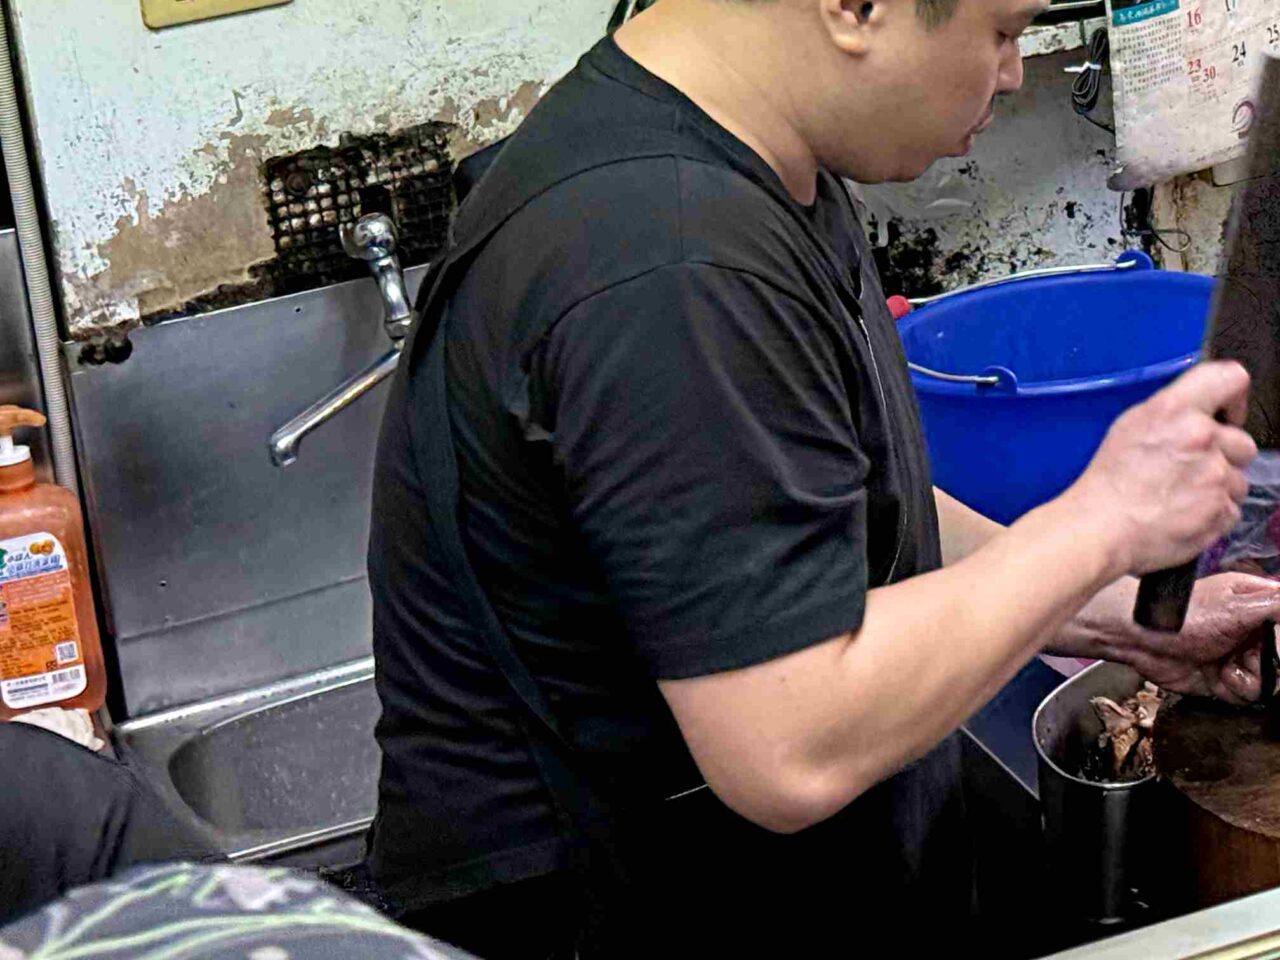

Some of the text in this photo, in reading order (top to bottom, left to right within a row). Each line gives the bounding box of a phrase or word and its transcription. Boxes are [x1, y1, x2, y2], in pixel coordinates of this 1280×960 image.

[1187, 7, 1201, 27] 16
[1187, 59, 1201, 75] 23
[1232, 41, 1246, 63] 24
[1267, 24, 1280, 44] 25
[1202, 66, 1216, 83] 30
